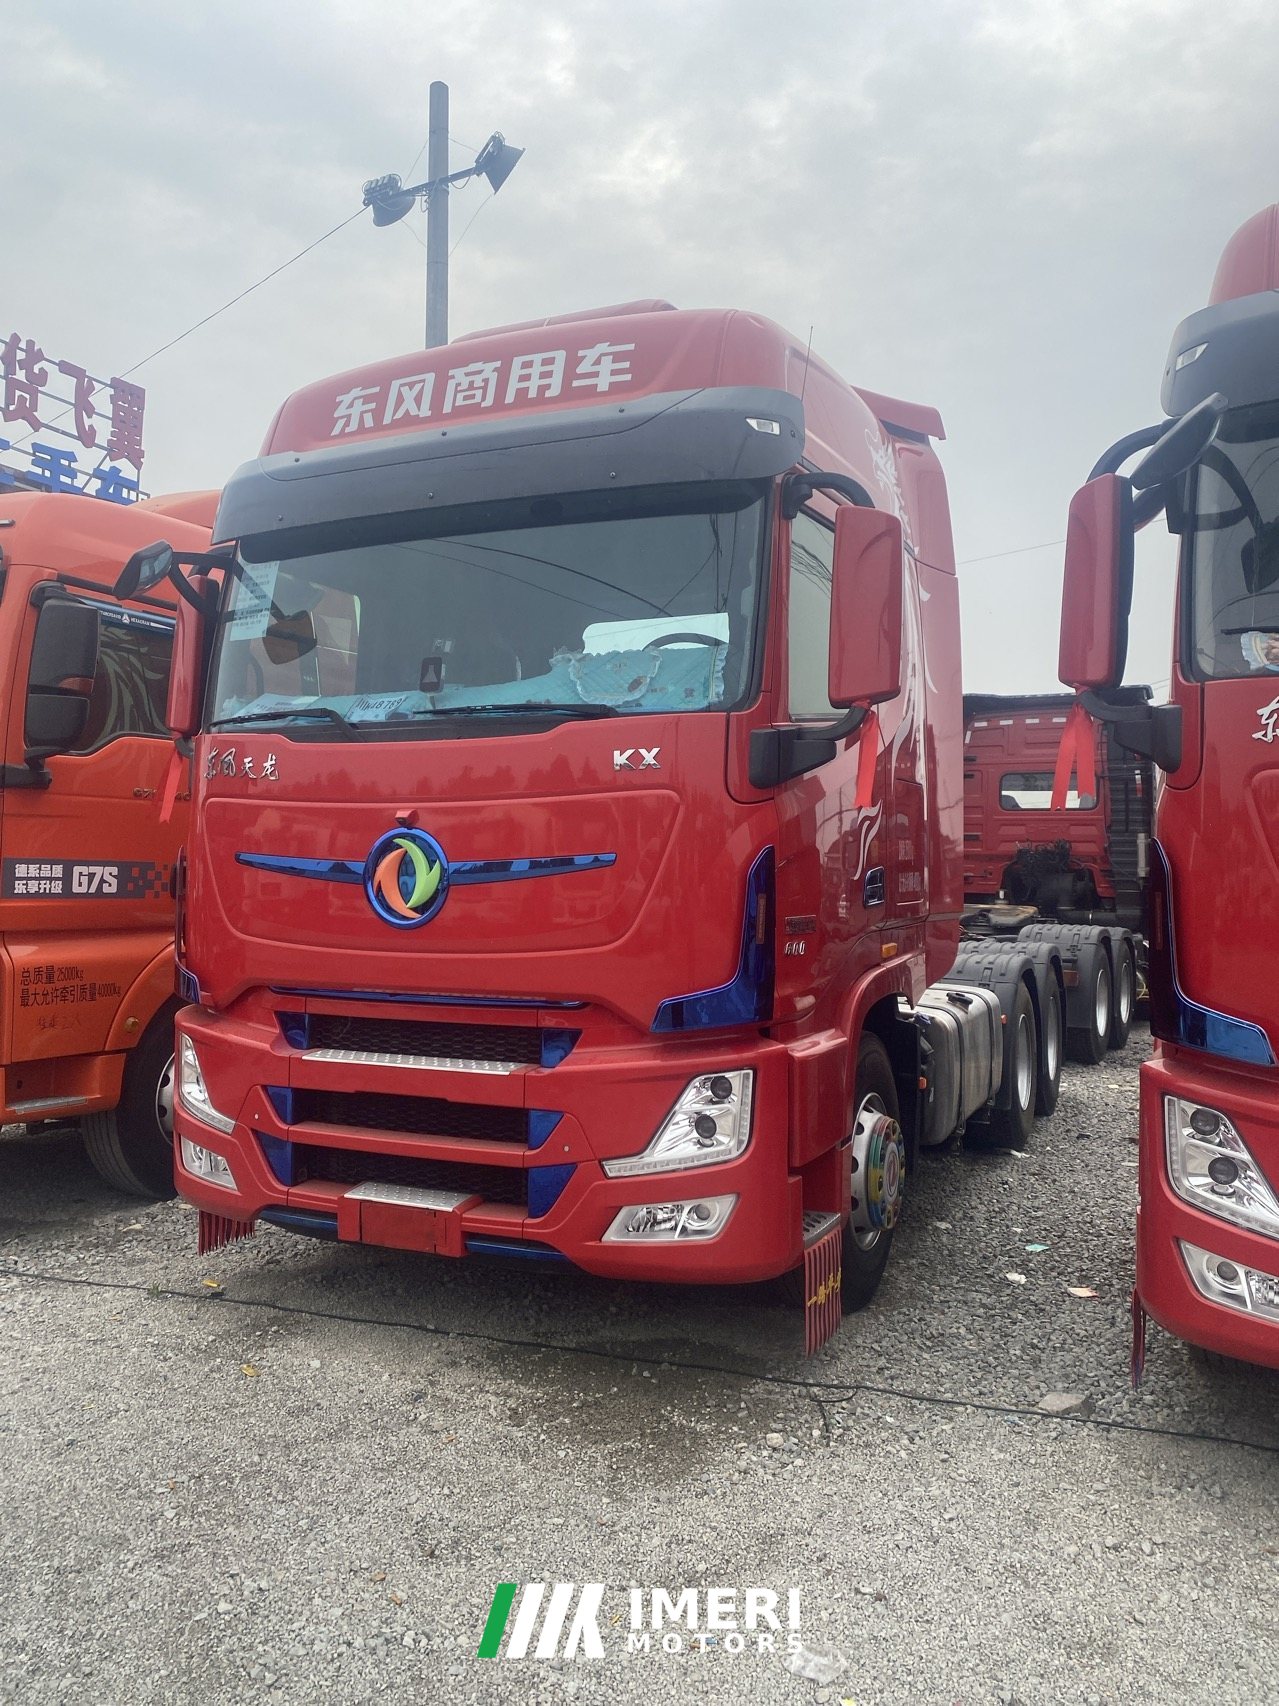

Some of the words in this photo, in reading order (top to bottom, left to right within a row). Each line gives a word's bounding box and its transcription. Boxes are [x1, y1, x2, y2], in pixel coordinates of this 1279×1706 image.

[0, 332, 146, 471] 货飞翼
[331, 342, 635, 436] 东风商用车
[0, 438, 139, 506] 手车
[613, 748, 661, 771] KX
[15, 864, 63, 878] 德系品质
[72, 865, 118, 894] G7S
[14, 880, 63, 894] 乐享升级
